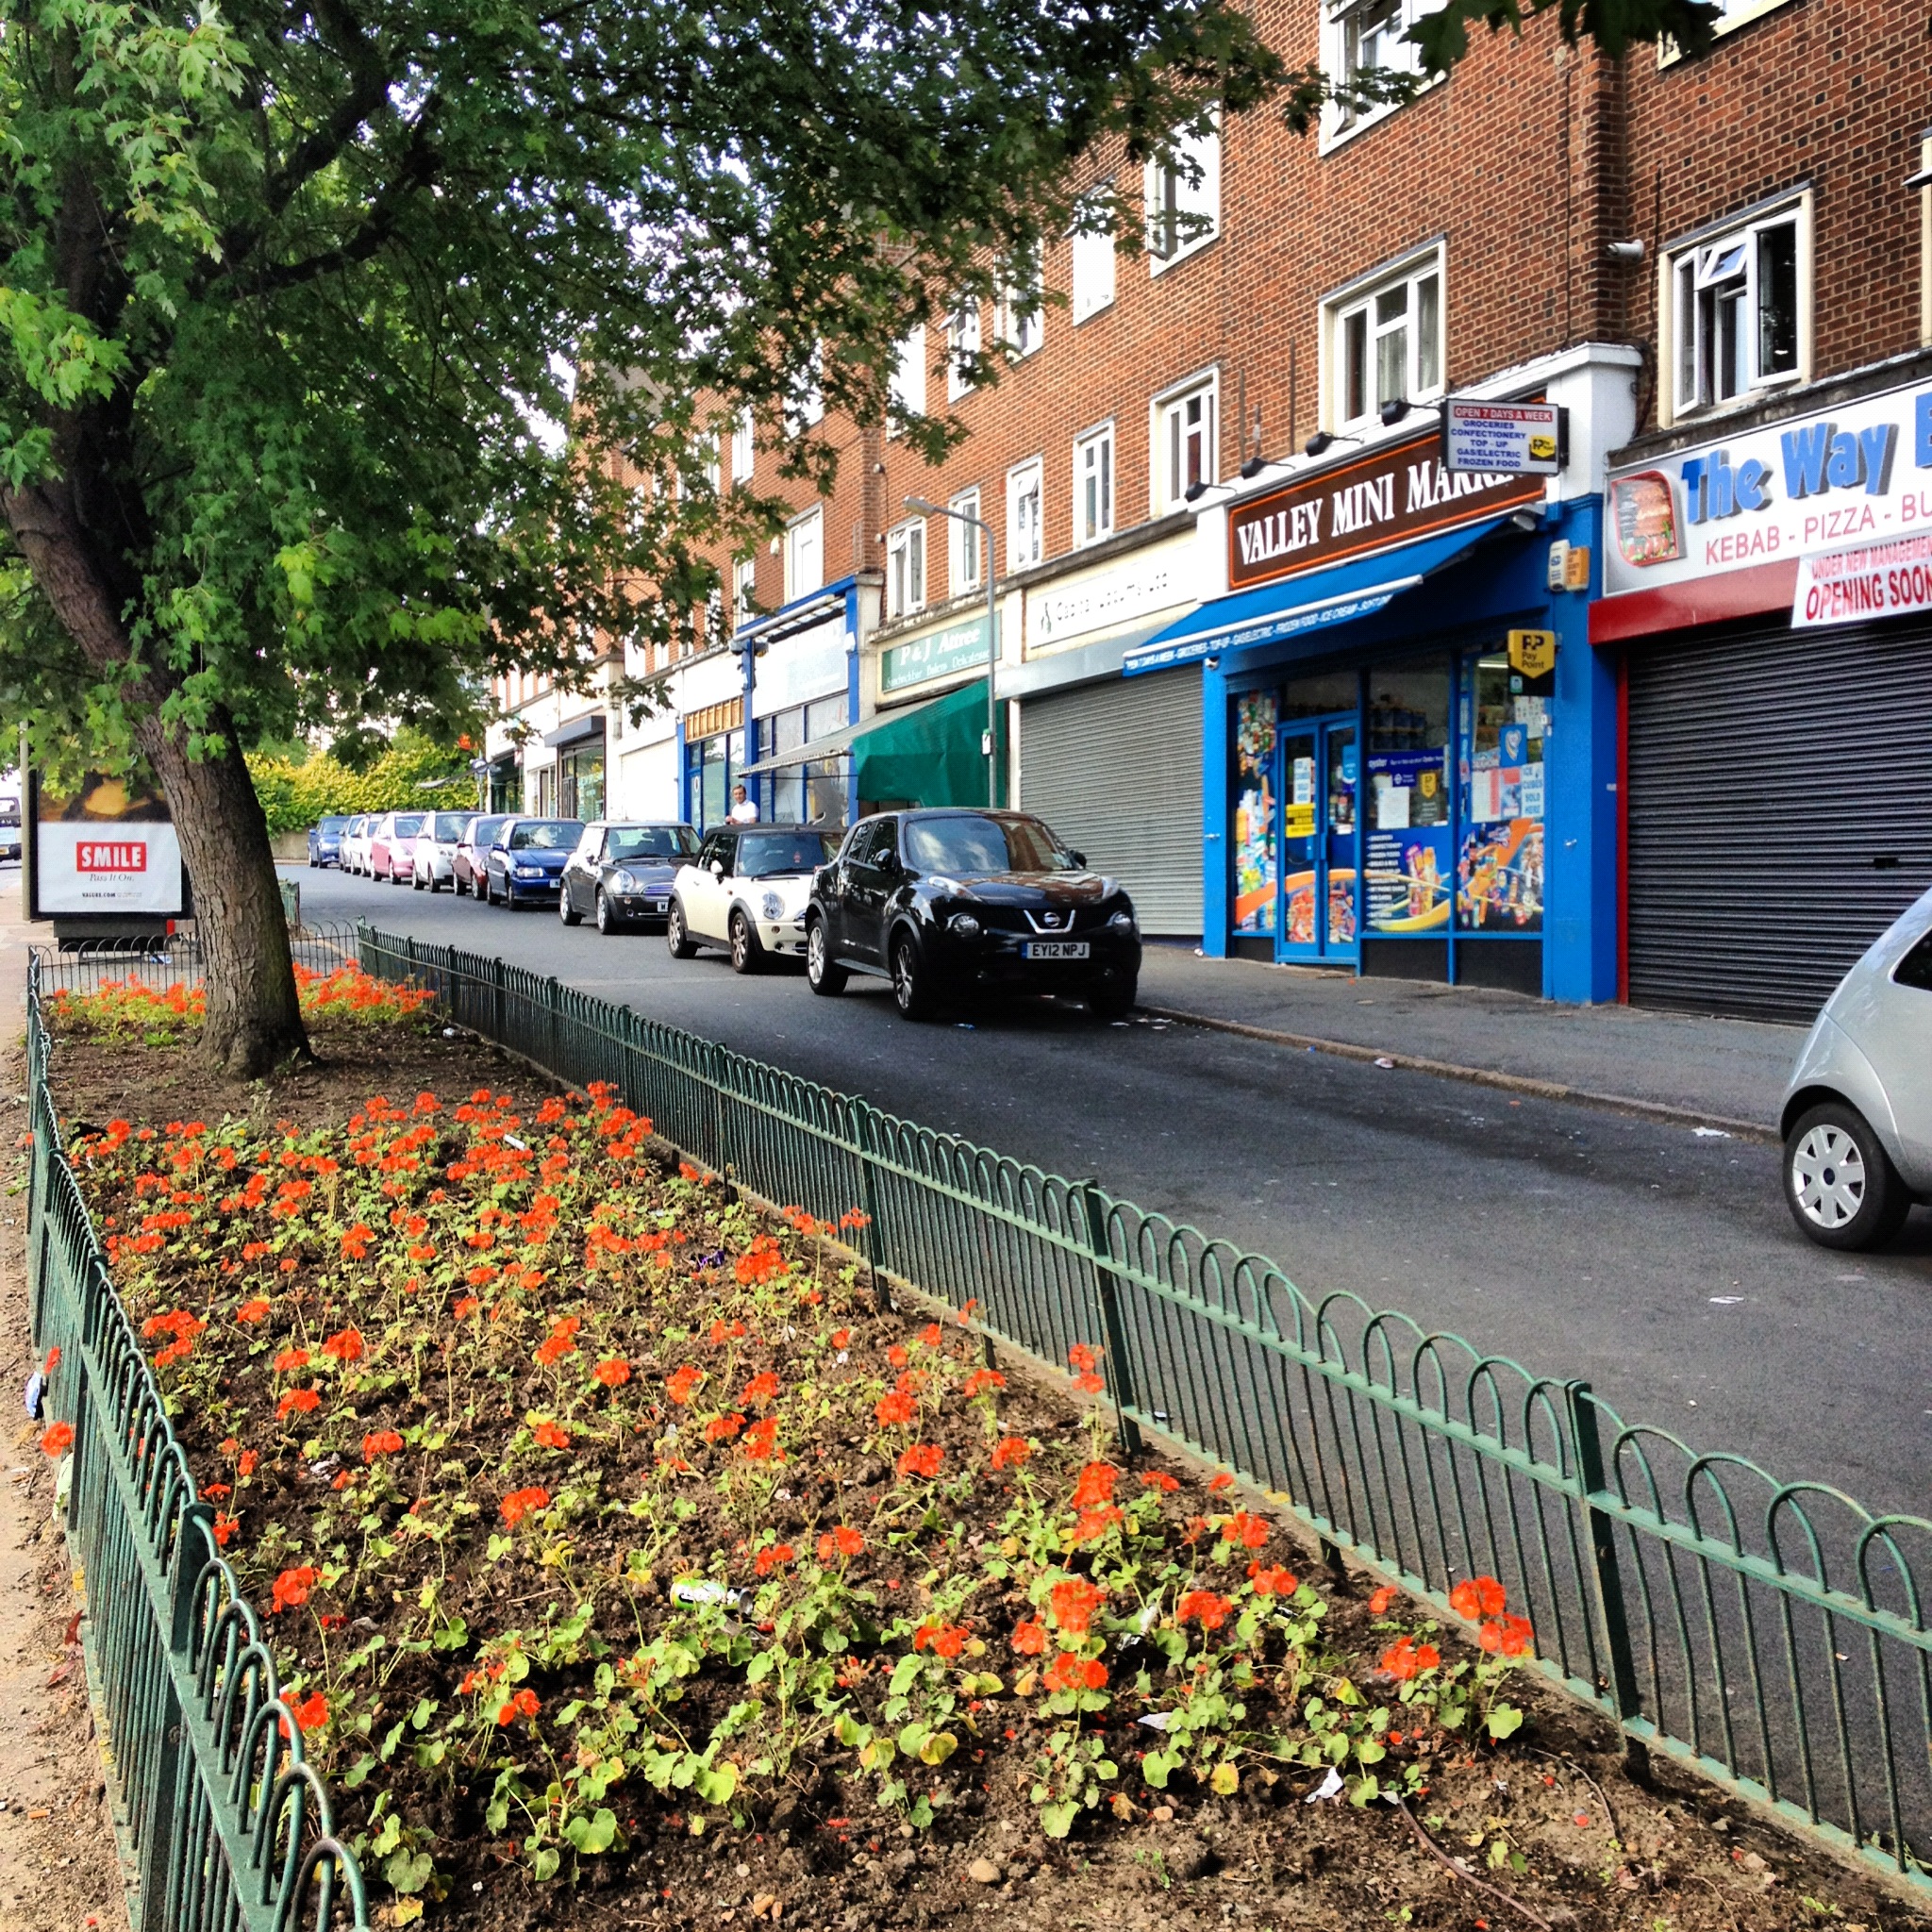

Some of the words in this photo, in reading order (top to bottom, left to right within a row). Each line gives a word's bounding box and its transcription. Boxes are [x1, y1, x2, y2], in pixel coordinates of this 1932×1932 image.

[1455, 406, 1481, 417] OPEN
[1483, 408, 1489, 418] 7
[1491, 408, 1514, 419] DAYS
[1515, 410, 1523, 420] A
[1524, 410, 1551, 421] WEEK
[1463, 420, 1515, 429] GROCERIES
[1451, 428, 1526, 440] CONFECTIONERY
[1471, 439, 1489, 447] TOP
[1457, 448, 1522, 458] GAS/ELECTRIC
[1457, 458, 1493, 467] FROZEN
[1681, 449, 1774, 525] The
[1780, 422, 1900, 499] Way
[1237, 498, 1324, 565] VALLEY
[1331, 473, 1395, 538] MINI
[1706, 525, 1780, 565] KEBAB
[1804, 504, 1876, 543] PIZZA
[1811, 554, 1843, 579] UNDER
[1846, 547, 1868, 572] NEW
[1806, 573, 1885, 621] OPENING
[900, 645, 911, 666] P
[911, 646, 923, 662] &
[923, 638, 932, 662] J
[1522, 651, 1537, 661] Pay
[1522, 660, 1545, 670] Point
[81, 846, 142, 867] SMILE
[90, 874, 108, 882] Pass
[109, 874, 116, 882] It
[1032, 943, 1059, 957] EY12
[1062, 943, 1086, 957] NPJ
